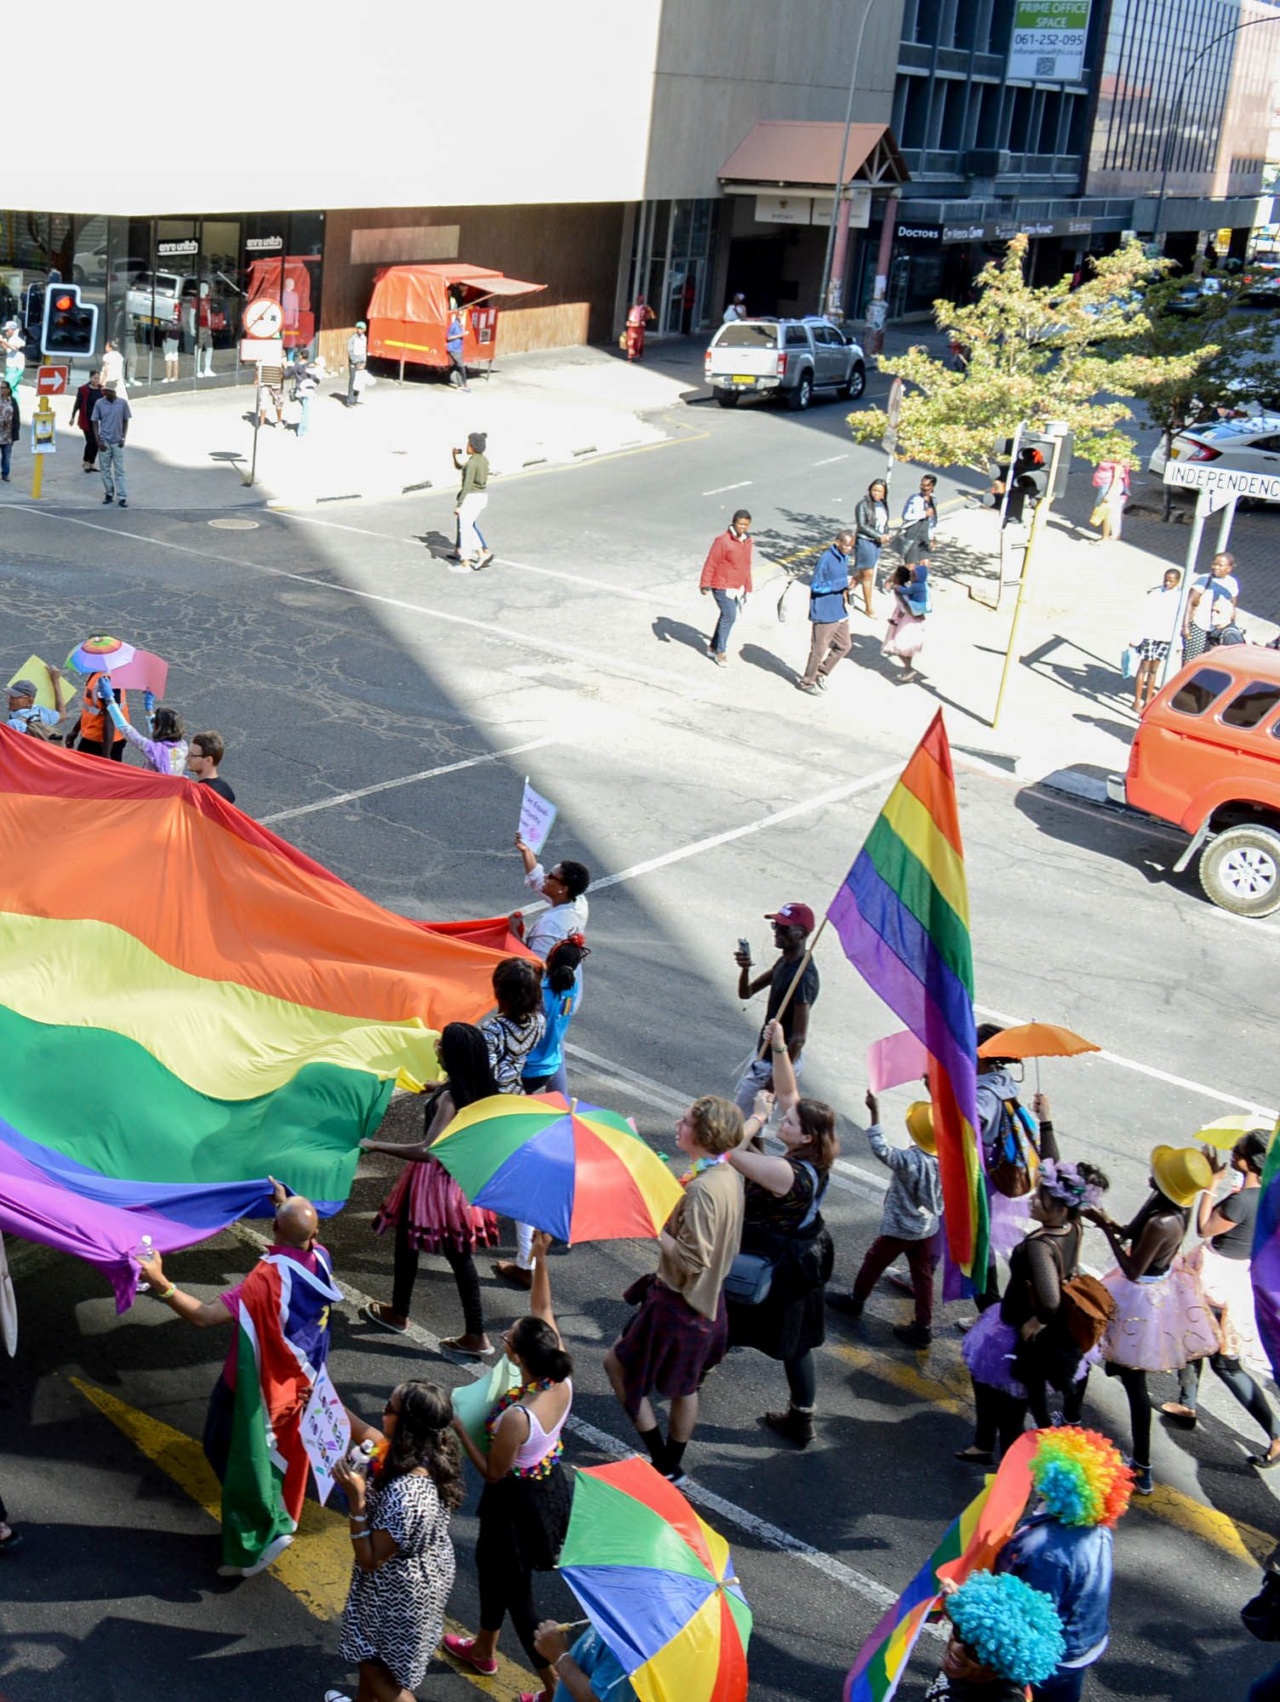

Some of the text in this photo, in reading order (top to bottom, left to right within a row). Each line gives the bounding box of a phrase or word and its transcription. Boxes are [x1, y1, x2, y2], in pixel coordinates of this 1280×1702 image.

[1020, 2, 1088, 13] PRIME OFFICE
[1036, 17, 1068, 28] SPACE
[1015, 34, 1083, 46] 061-252-095
